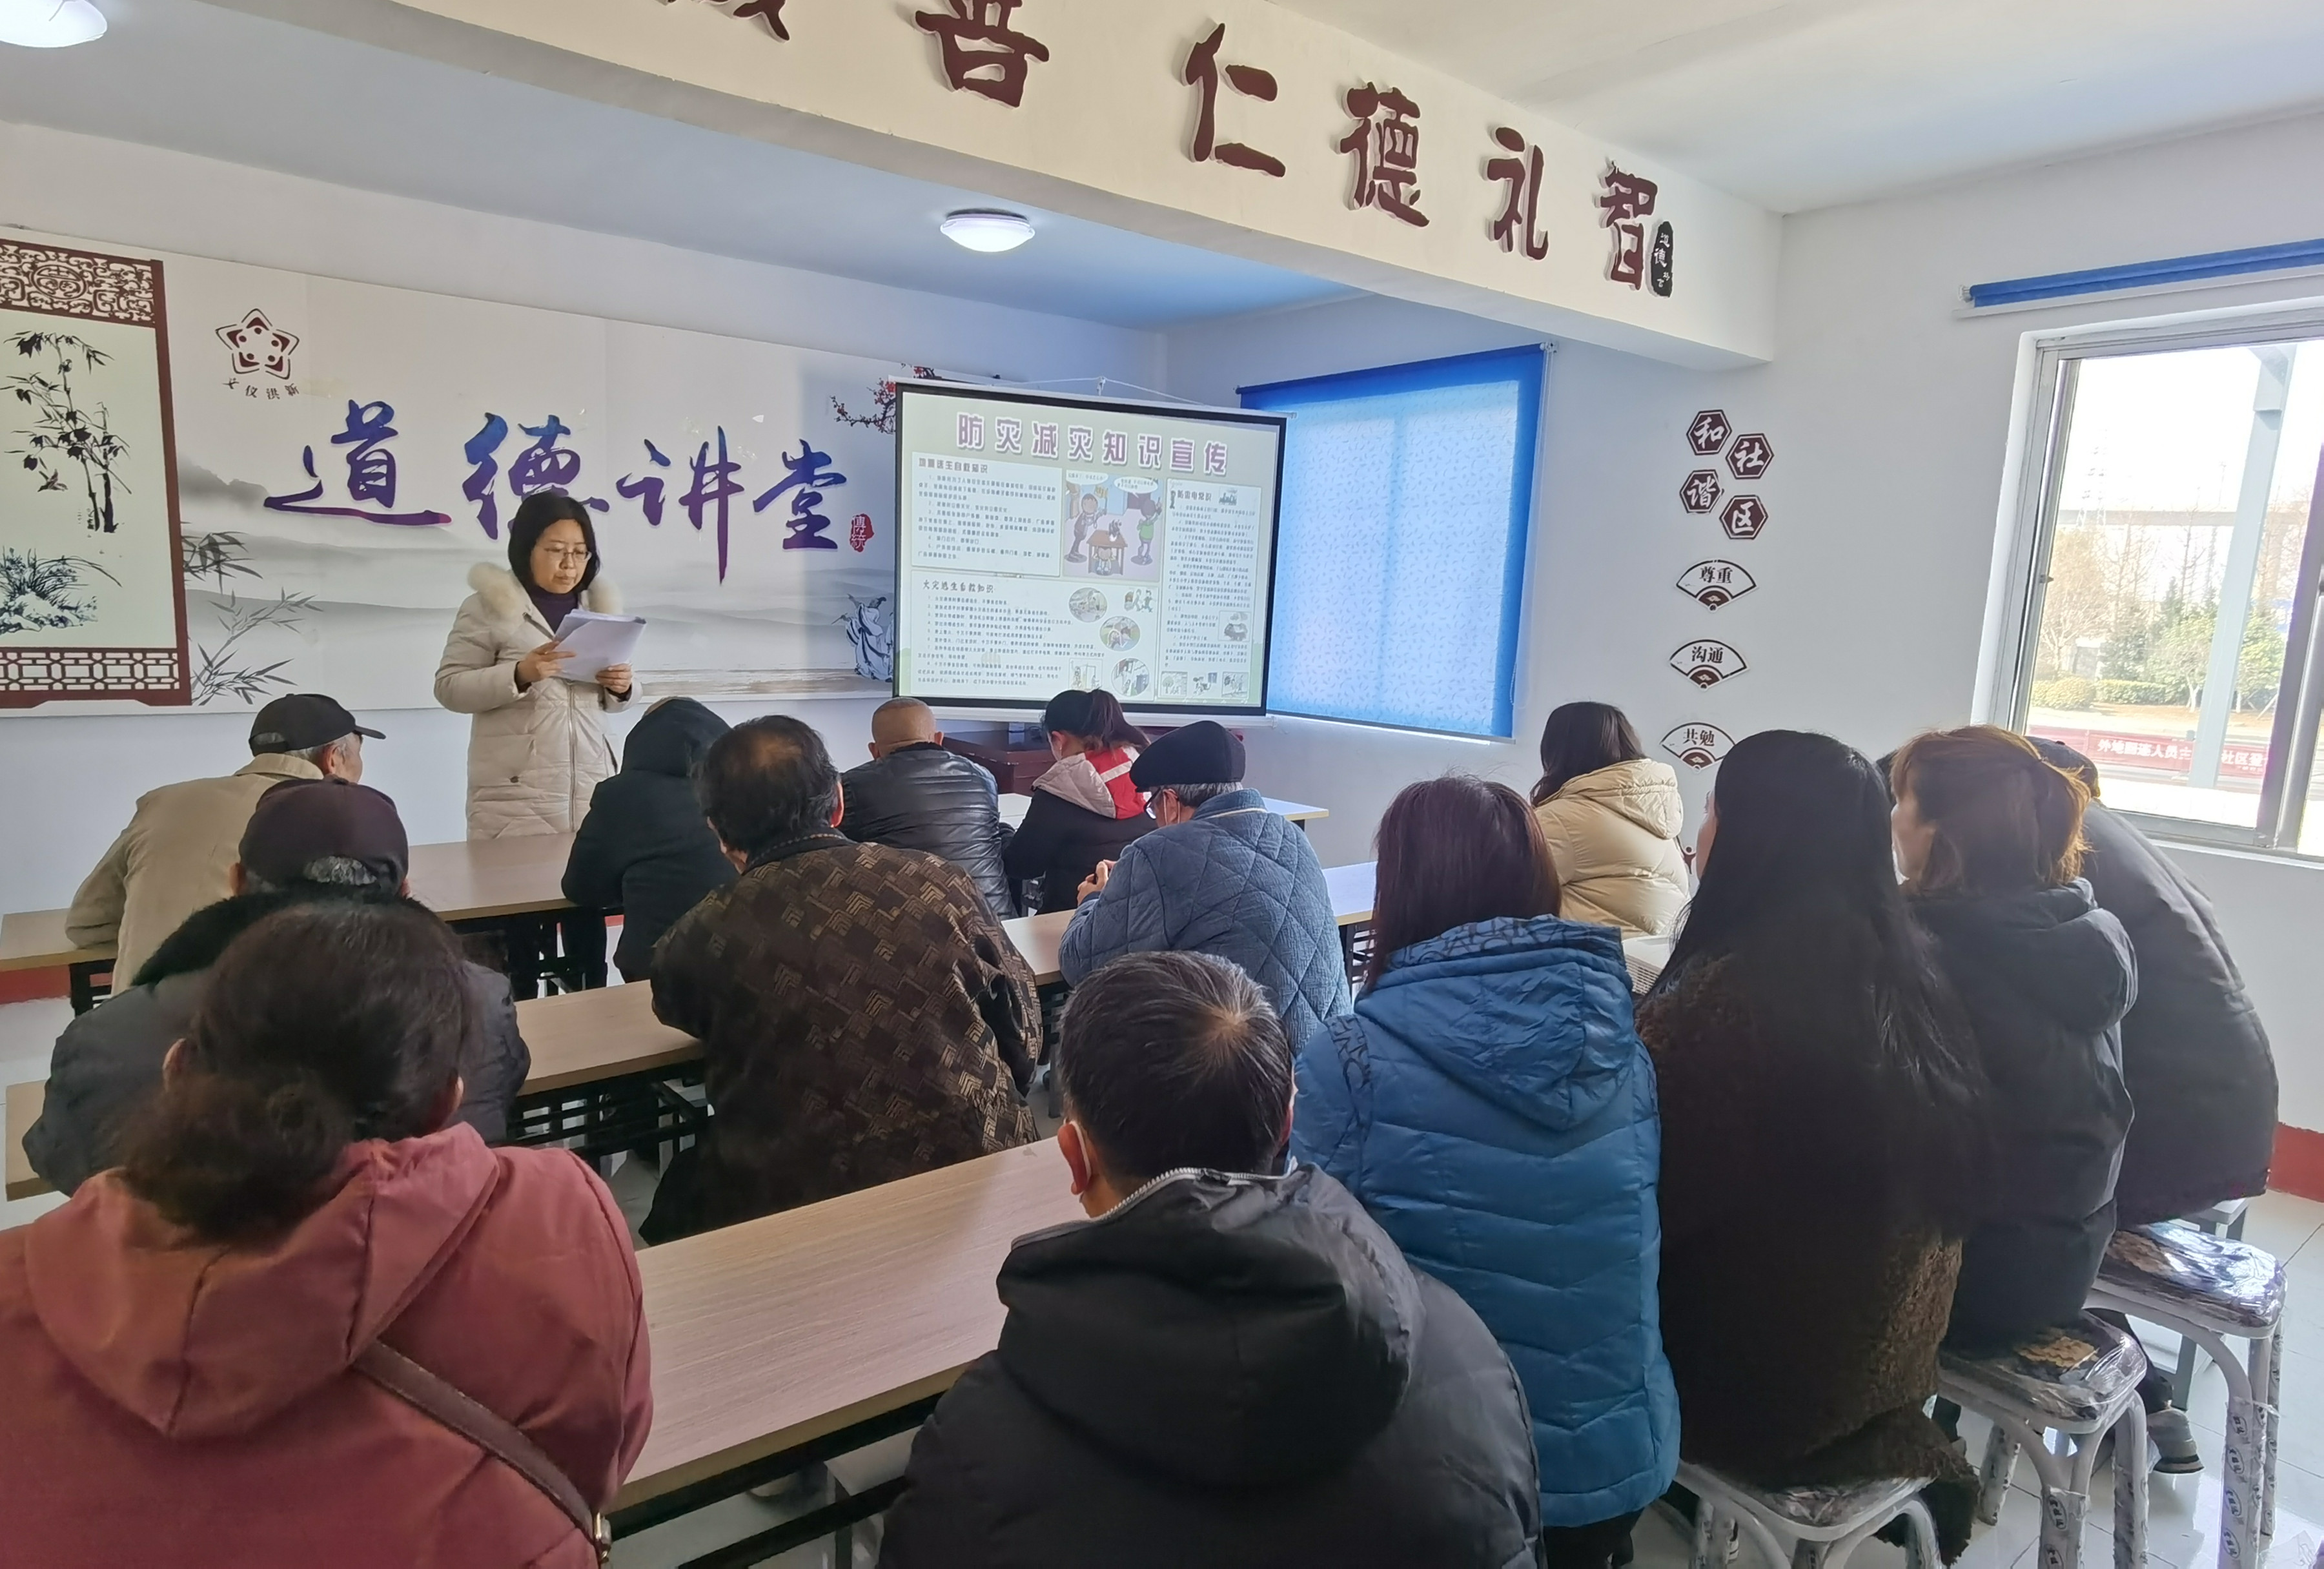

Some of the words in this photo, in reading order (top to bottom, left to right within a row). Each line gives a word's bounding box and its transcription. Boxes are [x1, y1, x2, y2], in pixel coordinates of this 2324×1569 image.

[957, 413, 1228, 477] 防灾减灾知识宣传
[263, 398, 848, 586] 道德讲堂
[1699, 566, 1733, 584] 尊重
[1691, 646, 1724, 664] 沟通
[1682, 728, 1715, 747] 共勉
